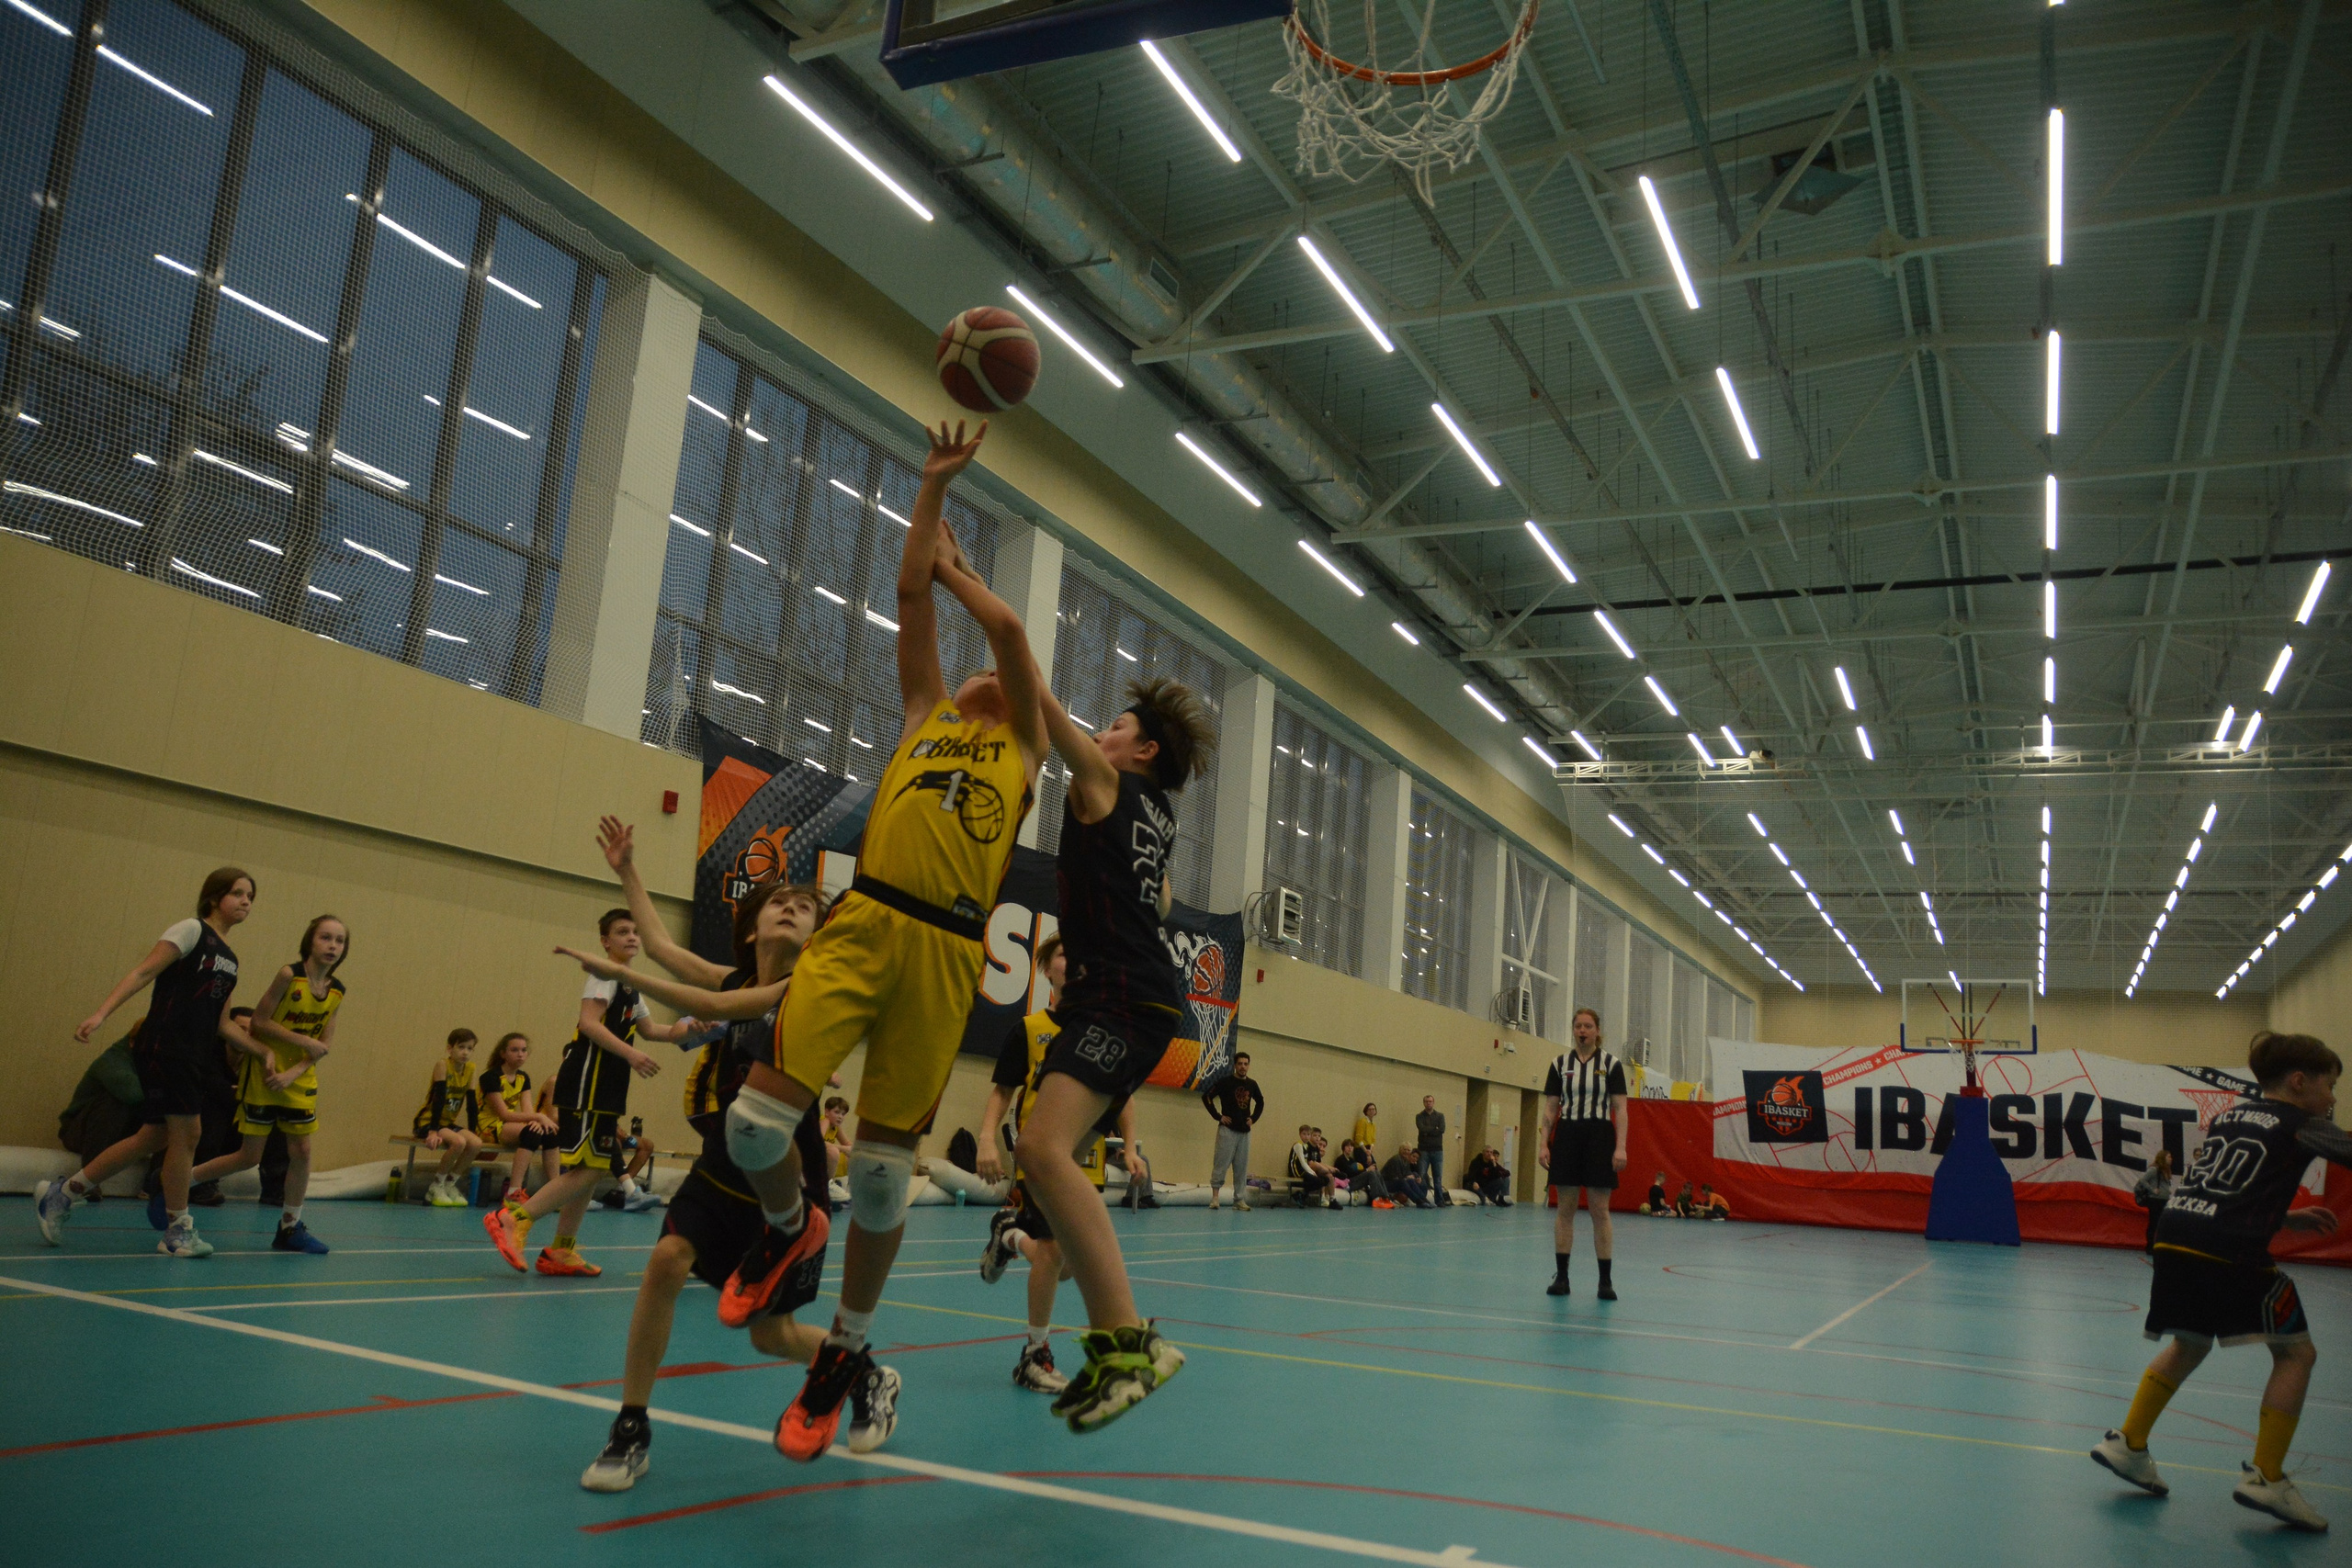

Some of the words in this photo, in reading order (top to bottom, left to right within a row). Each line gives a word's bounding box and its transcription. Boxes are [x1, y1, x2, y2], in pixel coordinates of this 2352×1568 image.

[940, 770, 964, 813] 1
[1075, 1024, 1126, 1073] 28
[1823, 1060, 1873, 1086] CHAMPIONS
[2216, 1076, 2247, 1093] GAME
[1713, 1100, 1747, 1116] AMPION
[1764, 1104, 1809, 1118] IBASKET
[2176, 1135, 2267, 1194] 20
